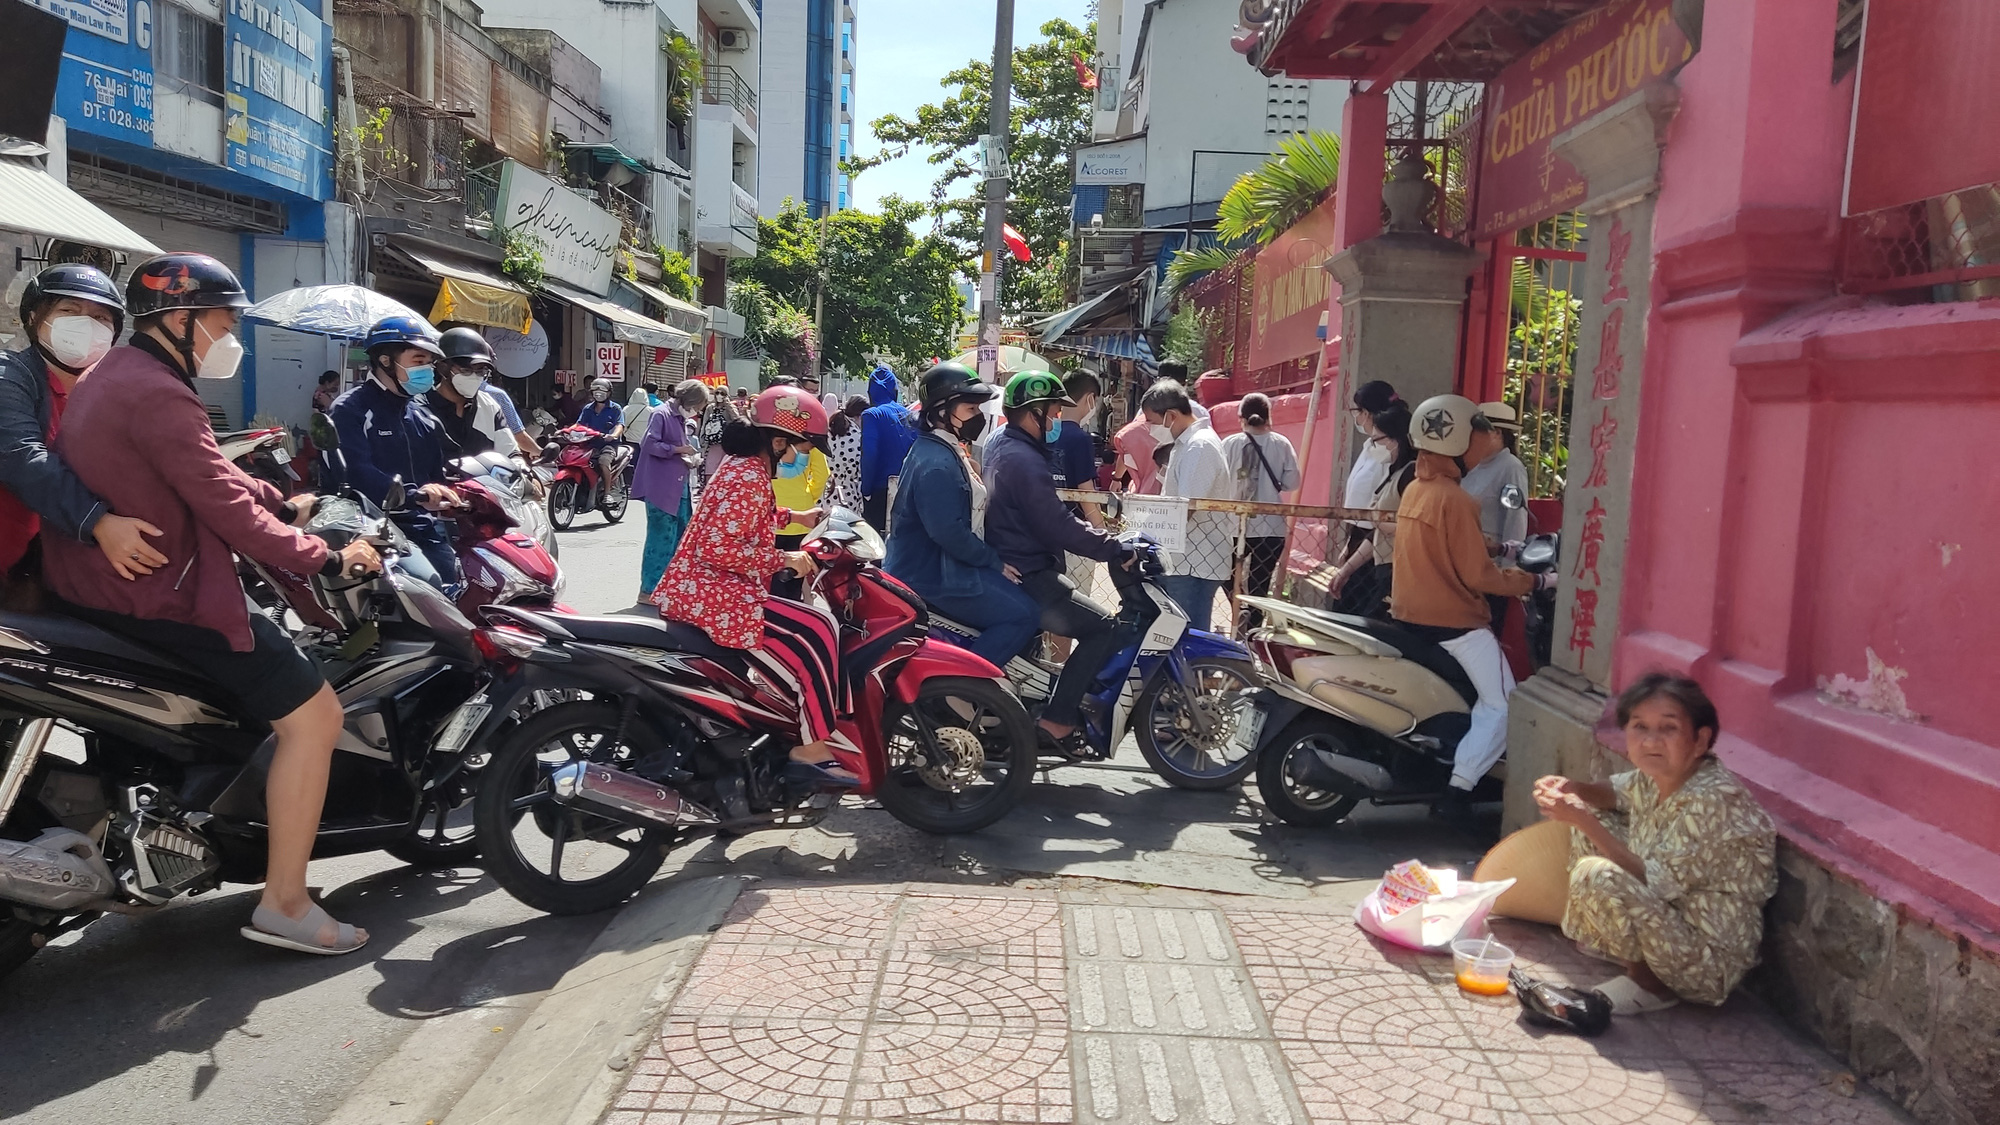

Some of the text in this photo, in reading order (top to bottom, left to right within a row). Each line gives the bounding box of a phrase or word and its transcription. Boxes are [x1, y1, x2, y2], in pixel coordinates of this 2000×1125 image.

[89, 16, 104, 30] Law
[1492, 0, 1671, 165] CHÙA PHƯỚC
[83, 101, 106, 122] ĐT:
[598, 345, 623, 361] GIỮ
[602, 362, 620, 375] XE
[53, 666, 137, 689] BLADE
